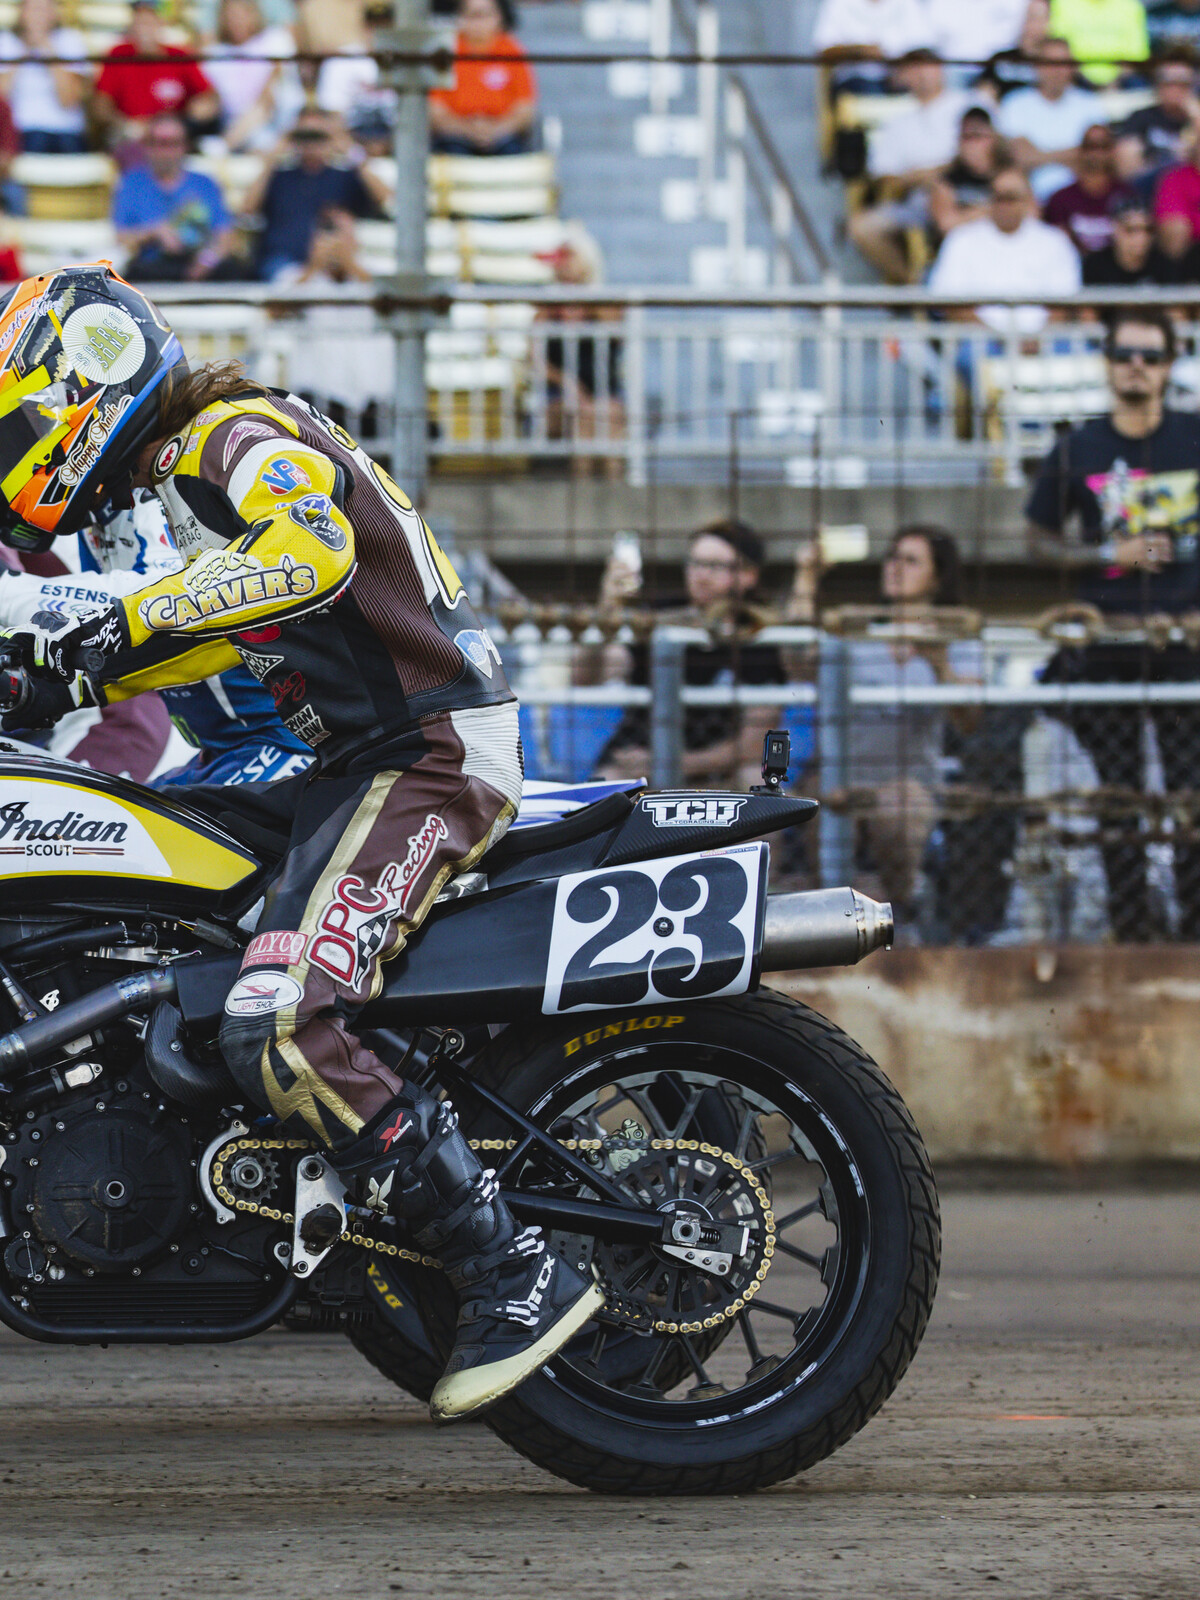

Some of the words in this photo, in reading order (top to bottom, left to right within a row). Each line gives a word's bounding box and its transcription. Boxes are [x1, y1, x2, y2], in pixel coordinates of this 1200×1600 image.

[75, 312, 124, 367] SACRED
[95, 328, 132, 370] SONS
[59, 441, 102, 486] Happy
[88, 394, 134, 444] Trails
[259, 458, 299, 493] VP
[141, 554, 316, 629] CARVER'S
[187, 552, 258, 593] BBQ
[646, 800, 740, 821] TCD
[25, 844, 73, 857] SCOUT
[309, 877, 388, 983] DPC
[383, 814, 448, 912] Racing
[557, 857, 749, 1011] 23
[563, 1014, 686, 1058] DUNLOP
[526, 1253, 556, 1305] TCX
